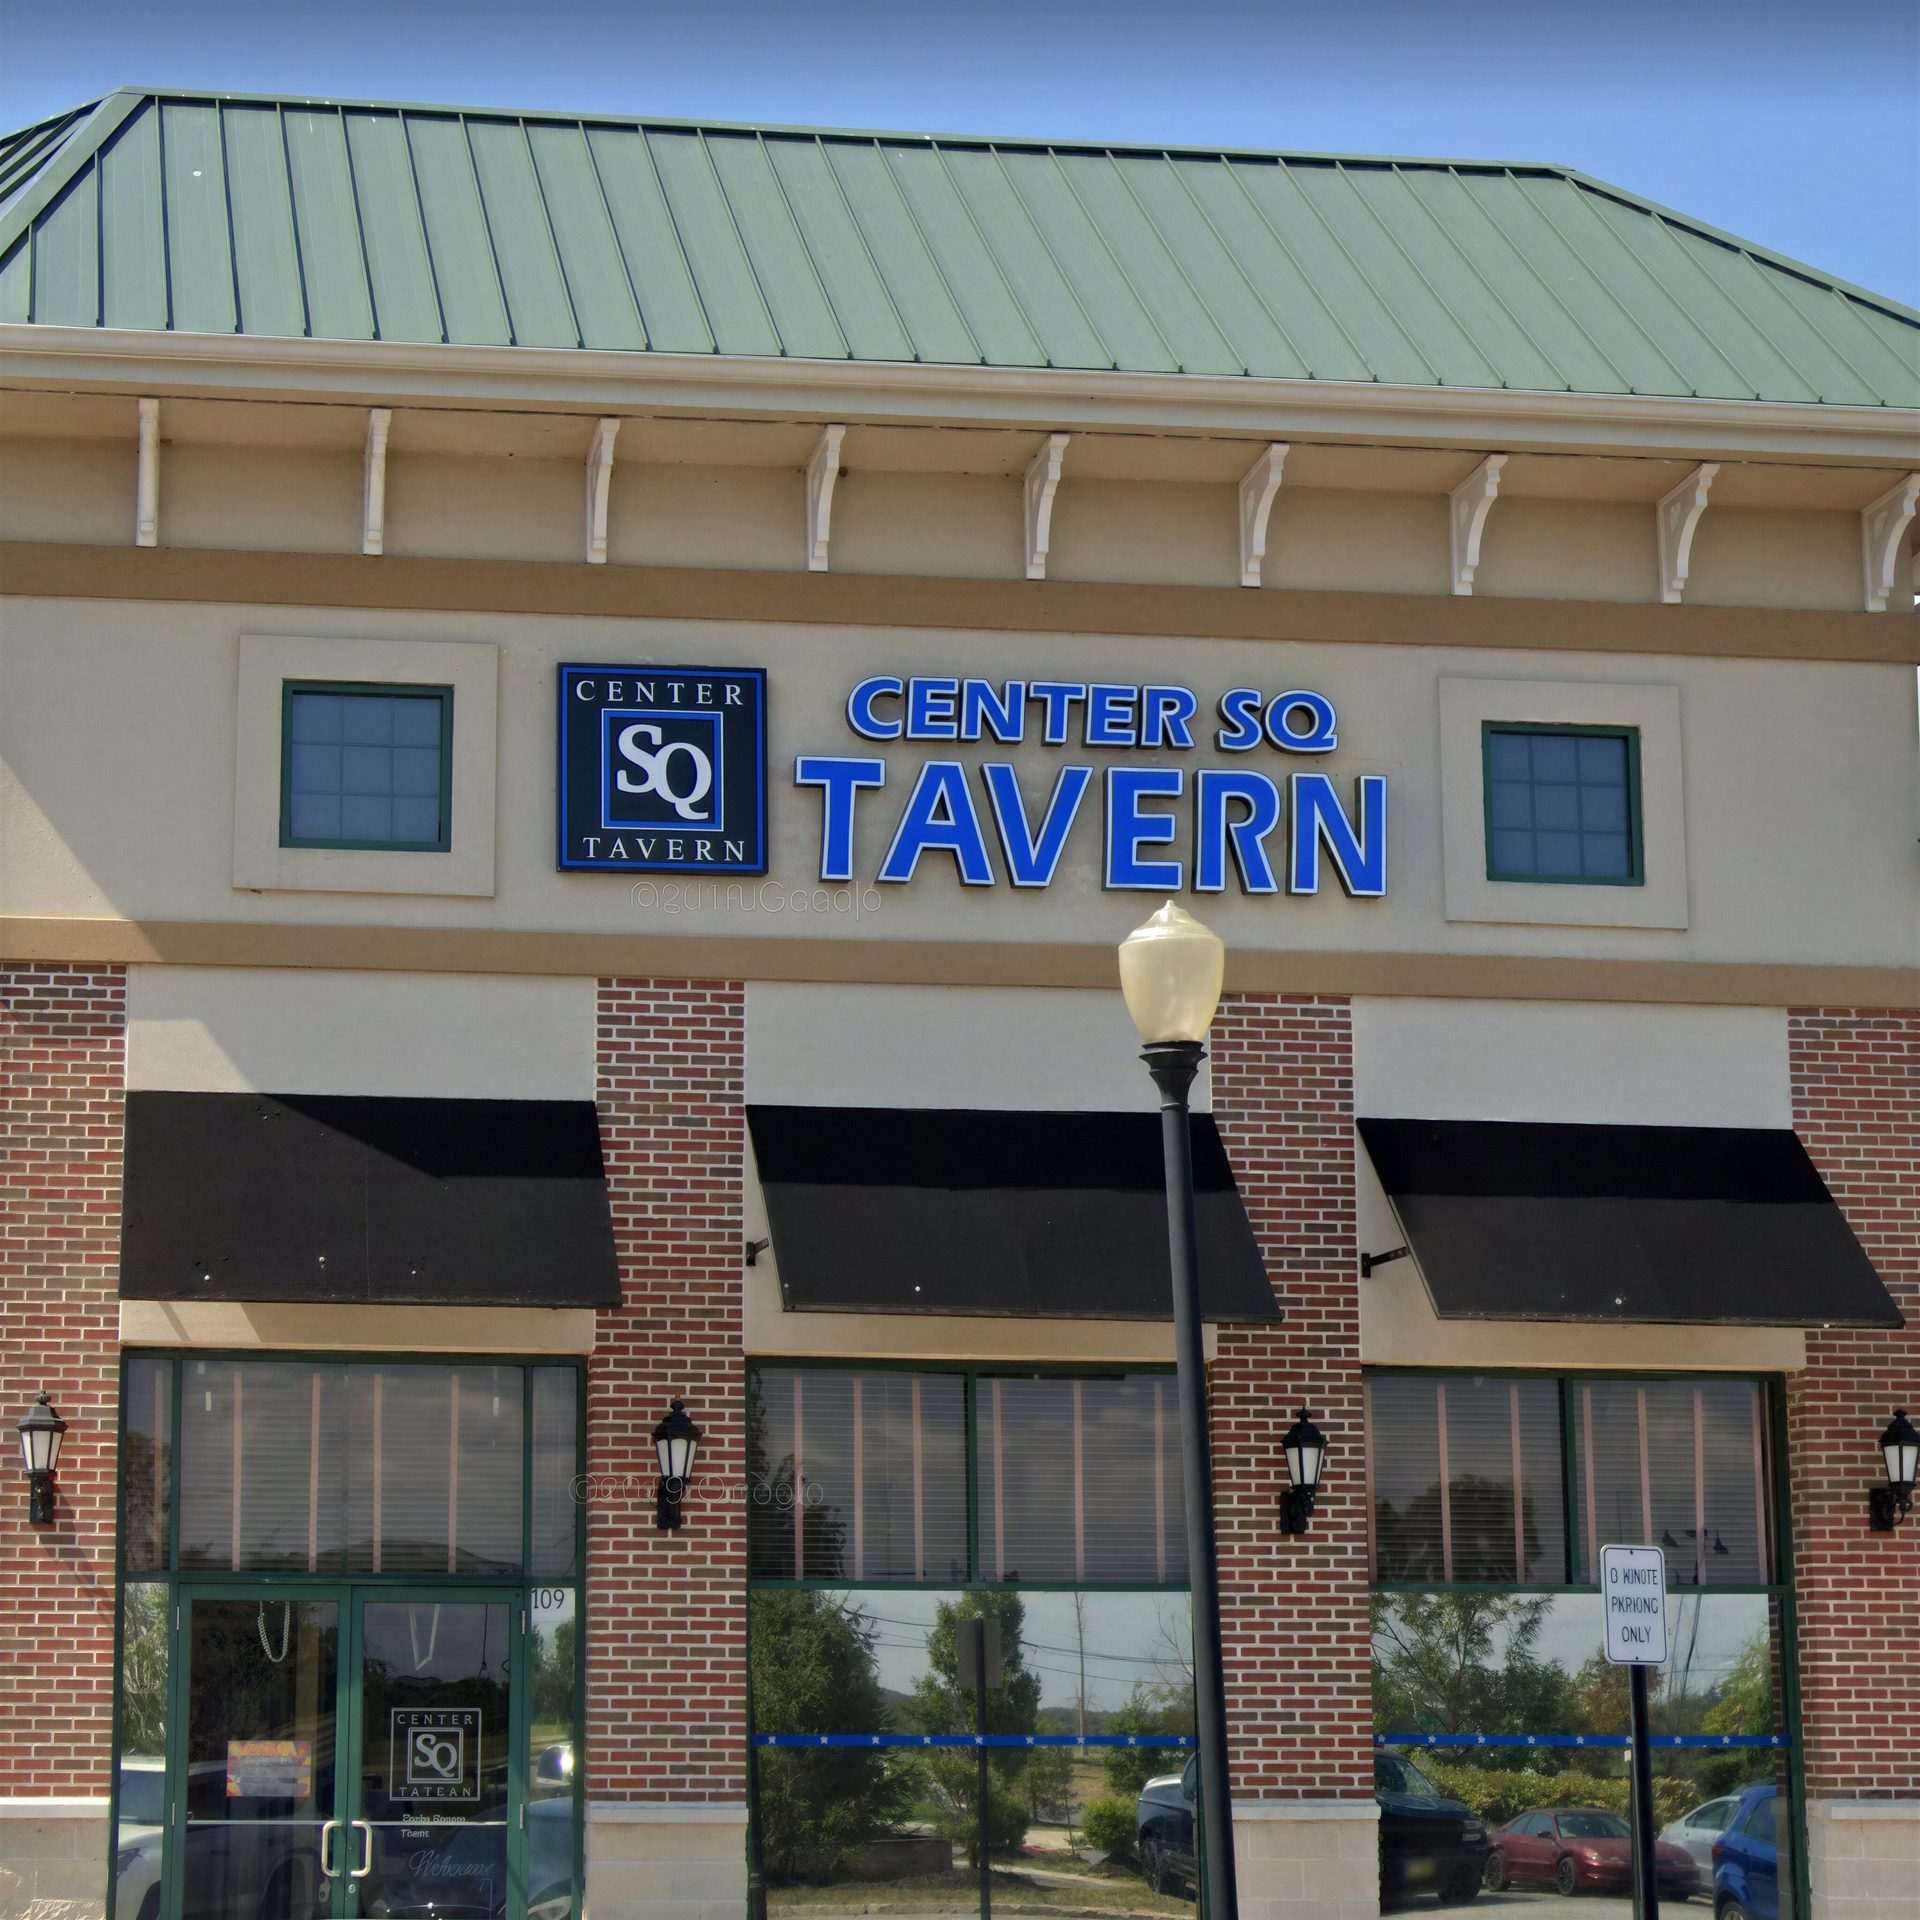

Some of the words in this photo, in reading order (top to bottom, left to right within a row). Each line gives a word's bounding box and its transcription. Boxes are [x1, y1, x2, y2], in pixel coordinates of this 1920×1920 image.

[575, 679, 744, 706] CENTER
[846, 674, 1199, 749] CENTER
[1214, 686, 1339, 754] SQ
[615, 723, 713, 821] SQ
[793, 755, 1389, 898] TAVERN
[582, 836, 746, 862] TAVERN
[531, 1588, 565, 1610] 109
[1621, 1626, 1652, 1643] ONLY
[397, 1714, 473, 1726] CENTER
[413, 1733, 458, 1778] SQ
